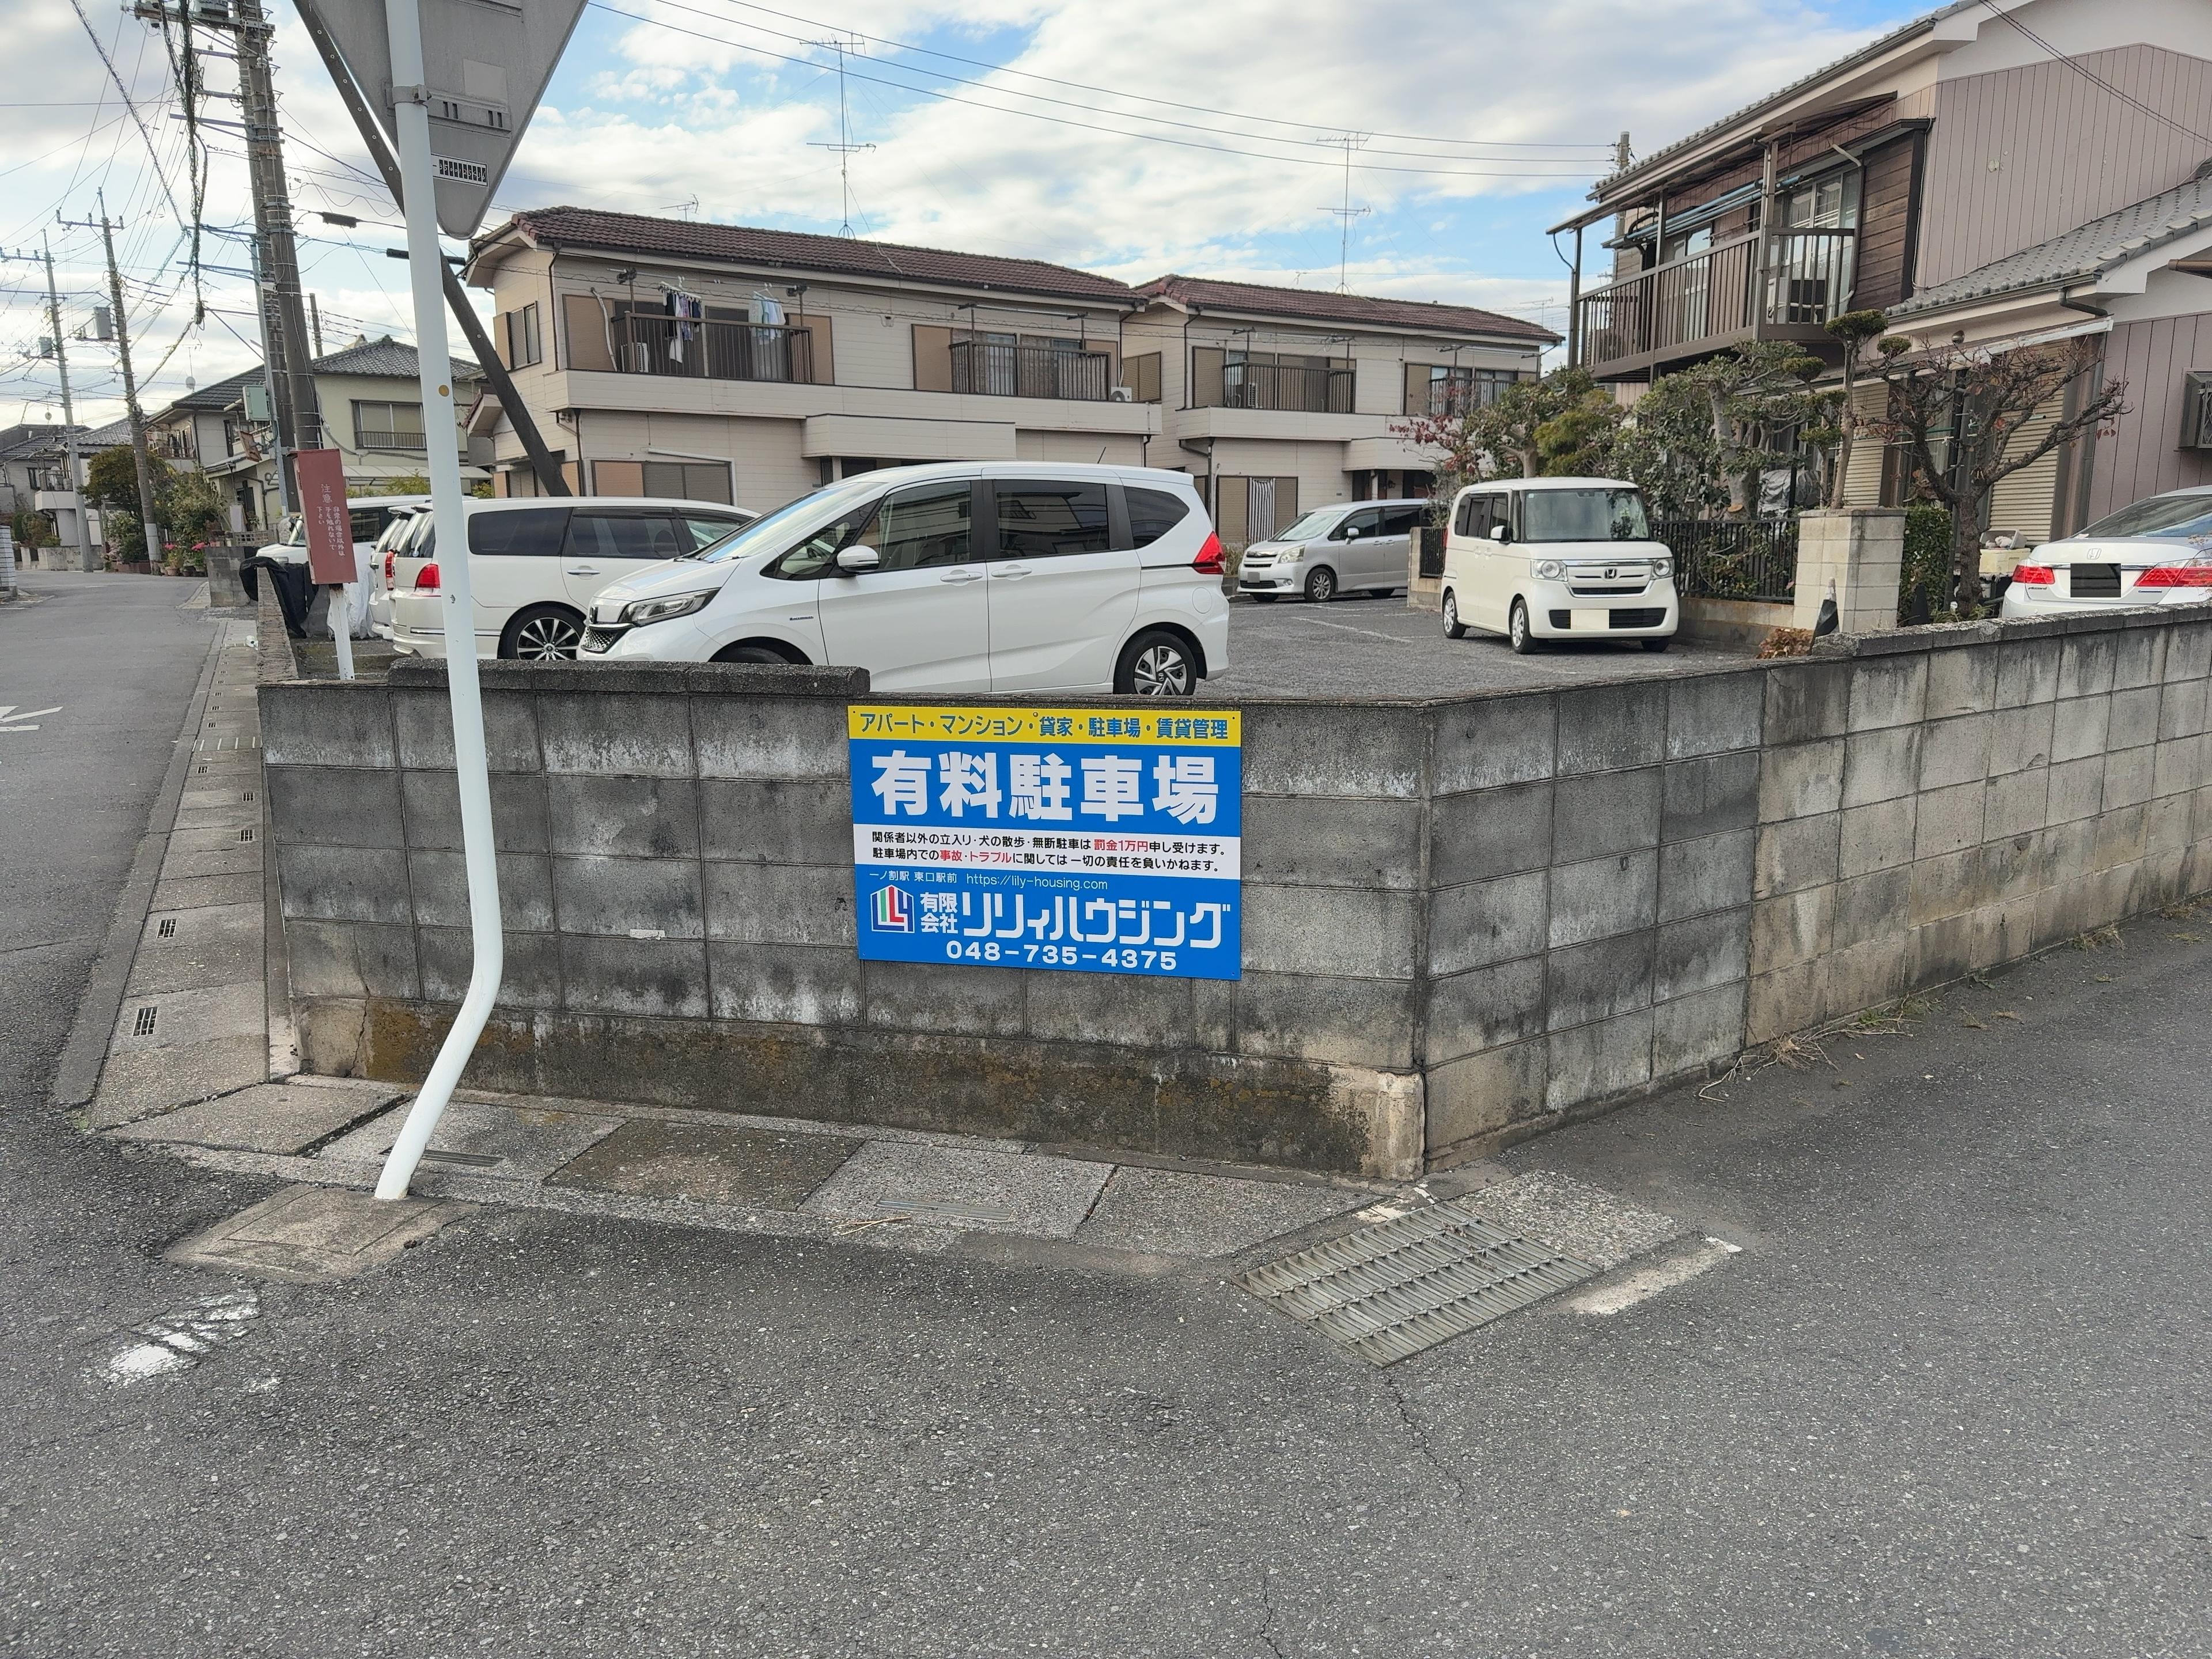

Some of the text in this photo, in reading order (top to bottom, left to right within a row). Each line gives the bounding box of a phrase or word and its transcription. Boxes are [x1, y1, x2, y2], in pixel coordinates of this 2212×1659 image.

[321, 483, 332, 503] 注意
[871, 750, 1218, 825] 有料駐車場
[967, 873, 1107, 891] https://lily-housing.com
[962, 892, 1230, 949] リリィハウジング
[946, 940, 1177, 970] 048-735-4375
